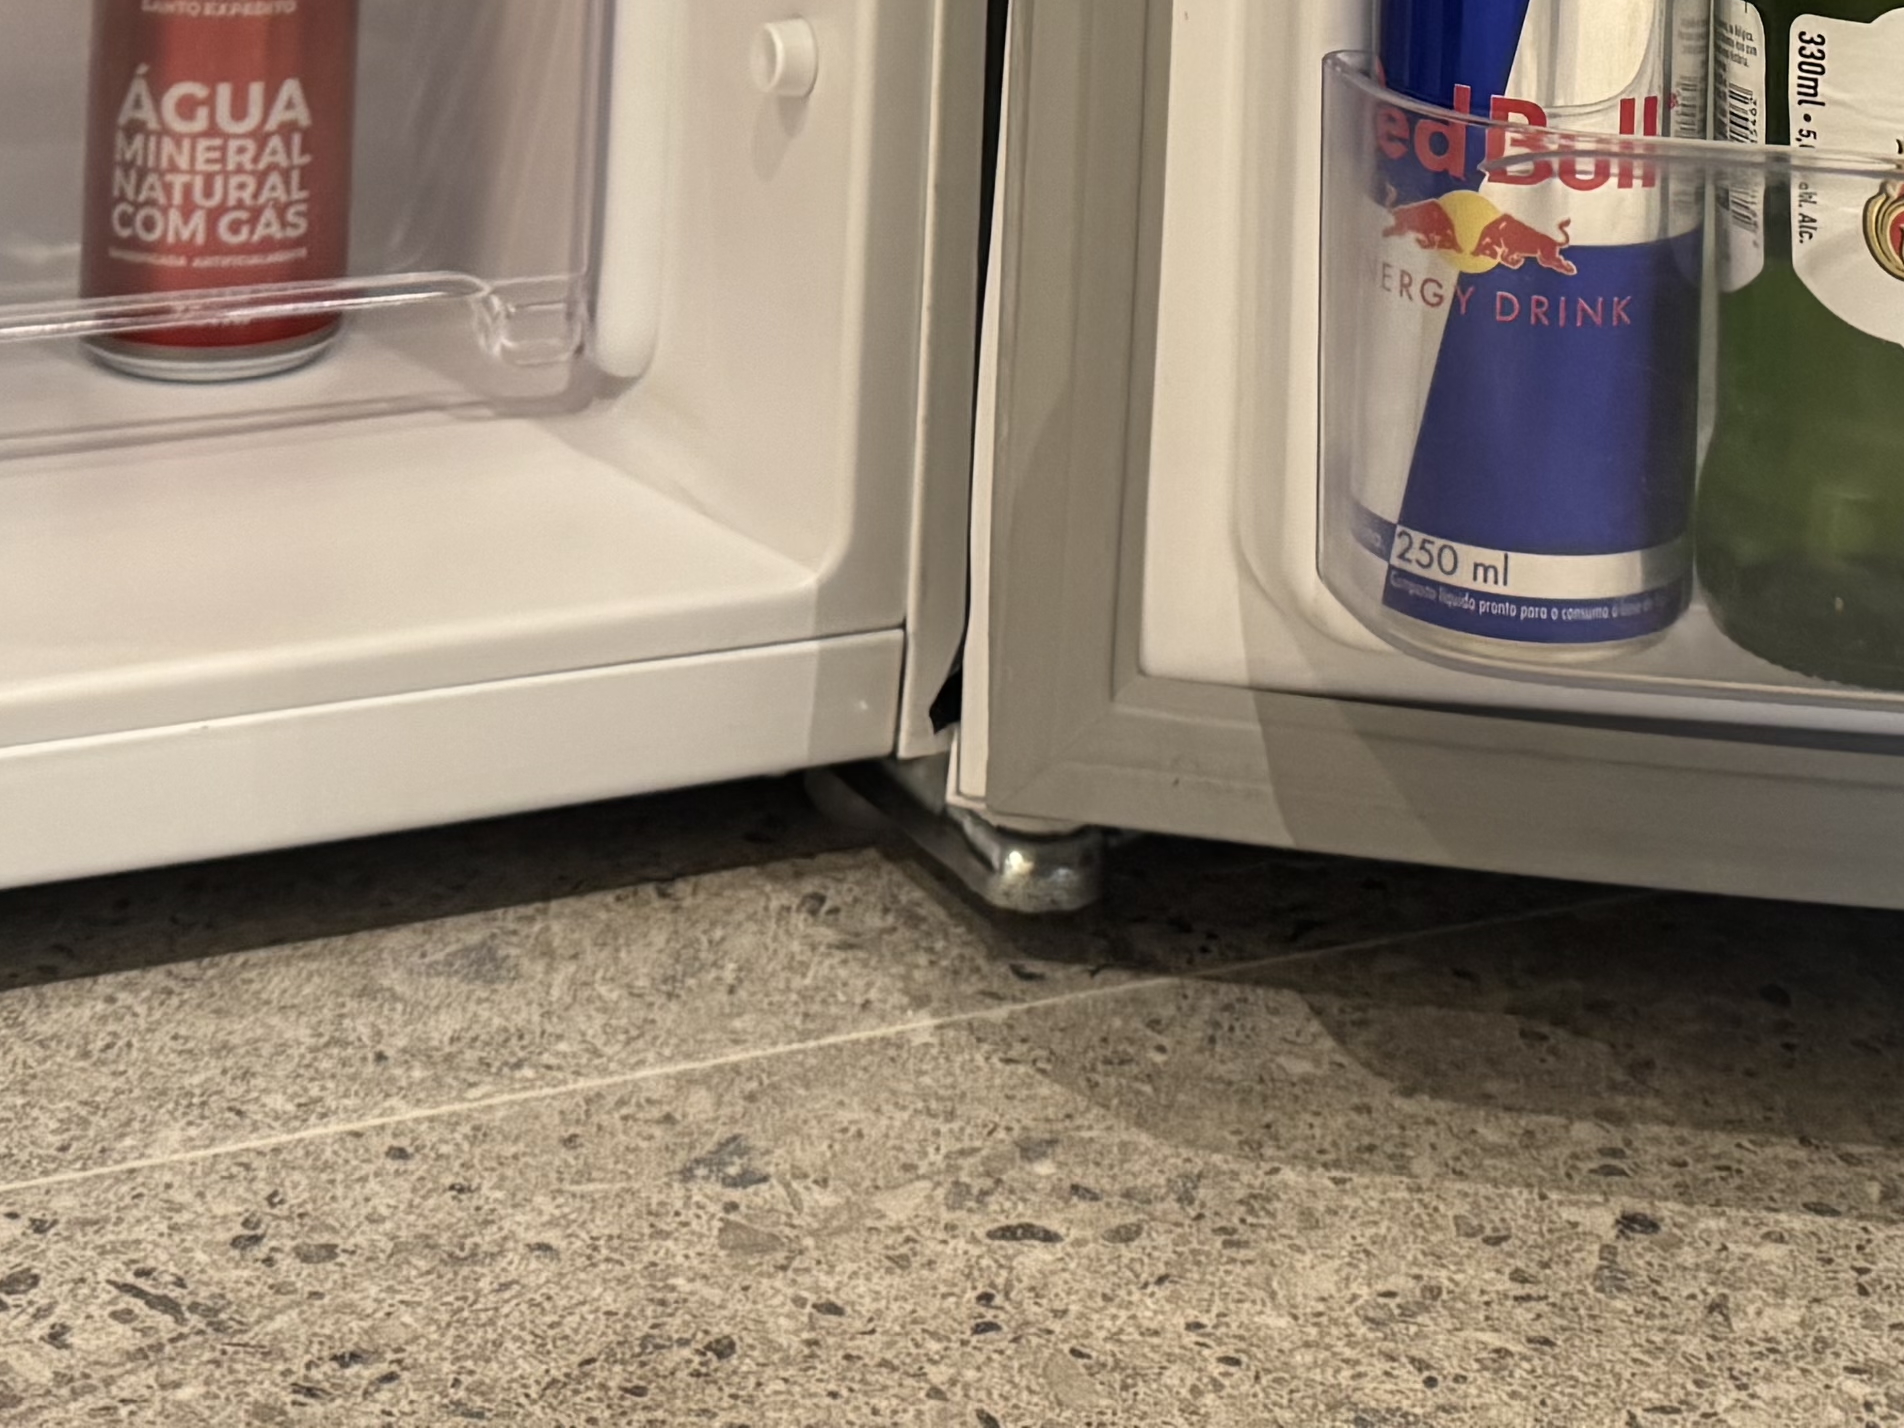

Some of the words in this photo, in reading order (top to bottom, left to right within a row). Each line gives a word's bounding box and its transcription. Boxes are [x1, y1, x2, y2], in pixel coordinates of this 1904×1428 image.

[1797, 30, 1827, 110] 330ml
[117, 62, 313, 135] ÁGUA
[1376, 56, 1471, 180] ed
[1486, 93, 1659, 192] Bull
[114, 131, 313, 172] MINERAL
[112, 165, 310, 209] NATURAL
[111, 202, 207, 245] COM
[217, 201, 309, 245] GÁS
[1497, 290, 1632, 327] DRINK
[1395, 529, 1458, 576] 250
[1472, 552, 1509, 587] ml
[1479, 598, 1516, 622] pronto
[1520, 604, 1547, 624] para
